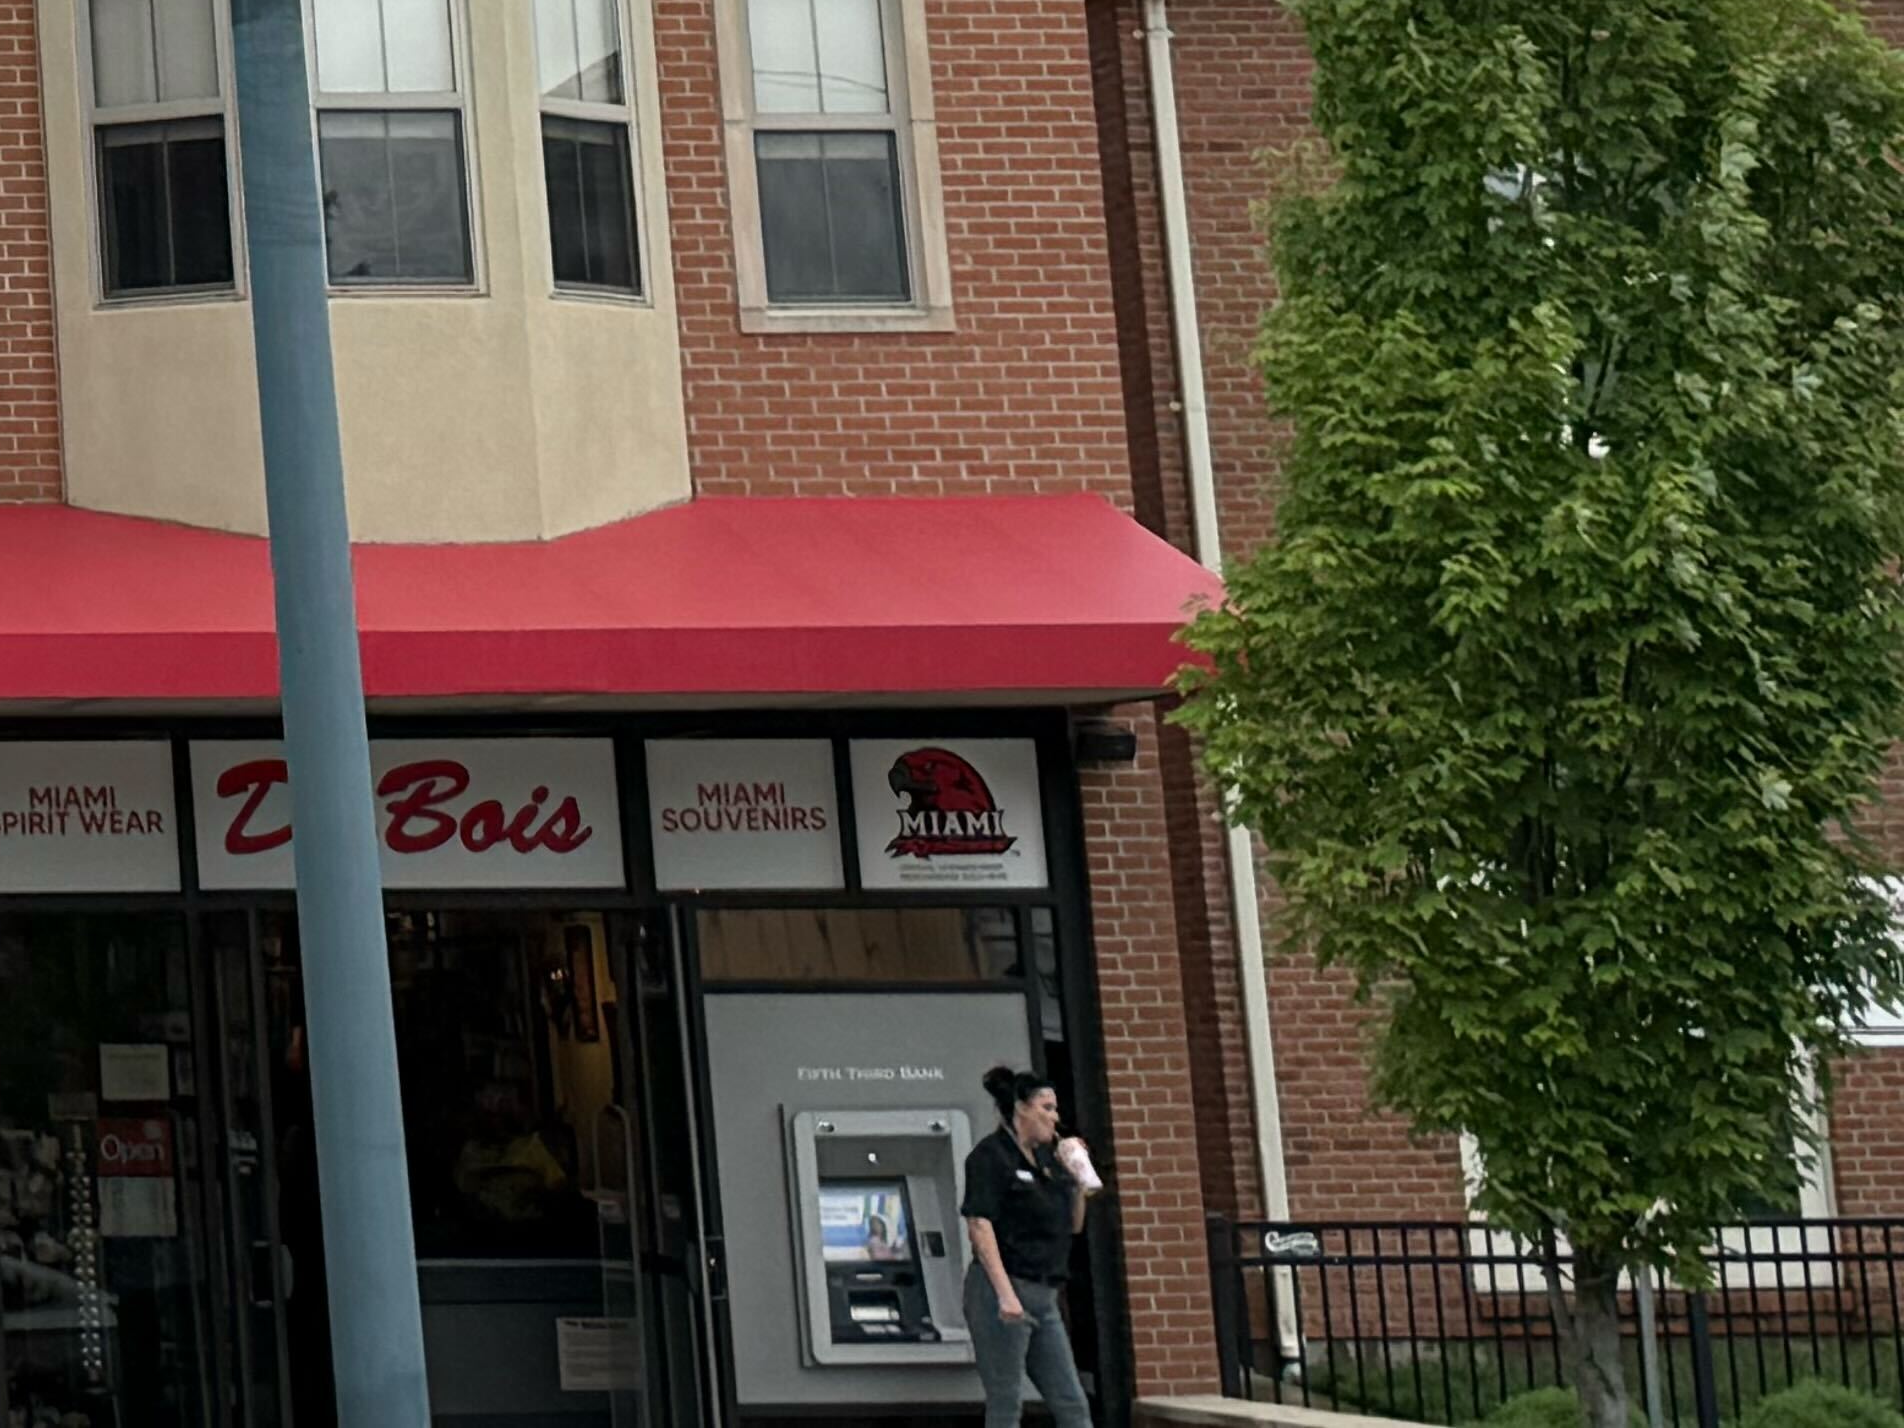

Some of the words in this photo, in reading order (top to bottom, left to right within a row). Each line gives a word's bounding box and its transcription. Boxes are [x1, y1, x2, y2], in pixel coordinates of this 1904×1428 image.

[28, 784, 116, 809] MIAMI
[216, 759, 294, 854] D
[376, 759, 593, 854] Bois
[697, 781, 786, 806] MIAMI
[78, 809, 165, 835] WEAR
[661, 806, 827, 832] SOUVENIRS
[901, 809, 1004, 837] MIAMI
